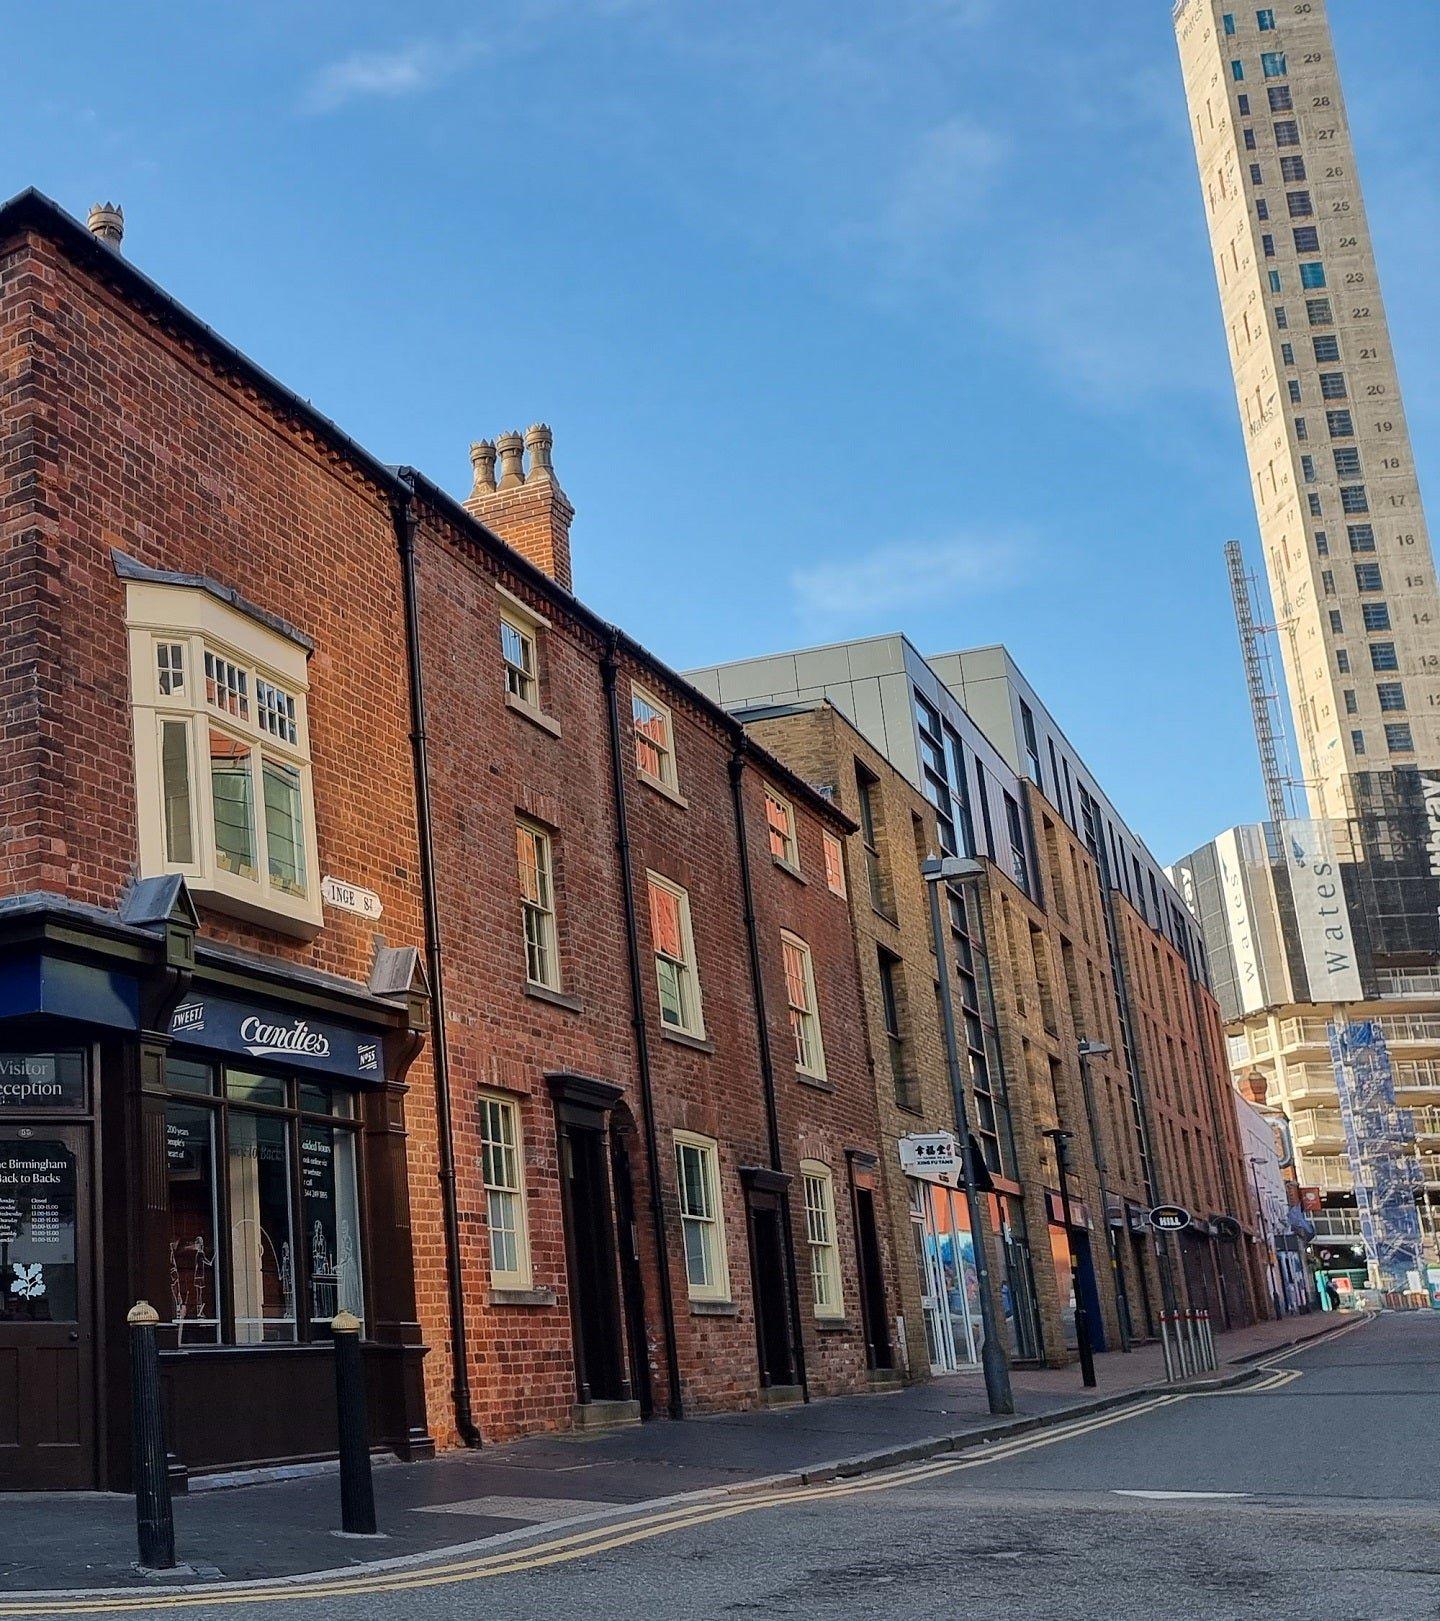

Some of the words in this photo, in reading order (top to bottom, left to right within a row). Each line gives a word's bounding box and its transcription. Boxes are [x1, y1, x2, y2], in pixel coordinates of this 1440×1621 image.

[1294, 3, 1312, 15] 30
[1304, 53, 1322, 63] 29
[1313, 96, 1331, 107] 28
[1319, 130, 1335, 140] 27
[1325, 167, 1344, 178] 26
[1332, 202, 1350, 212] 25
[1339, 237, 1358, 248] 24
[1346, 273, 1365, 283] 23
[1352, 308, 1372, 319] 22
[1360, 348, 1377, 359] 21
[1367, 385, 1386, 396] 20
[1374, 421, 1393, 433] 19
[1381, 458, 1400, 469] 18
[1389, 495, 1406, 507] 17
[1396, 534, 1415, 546] 16
[1405, 576, 1424, 588] 15
[1412, 612, 1431, 624] 14
[1419, 655, 1439, 667] 13
[331, 885, 355, 906] INGE
[1314, 862, 1351, 975] Wates
[172, 1006, 204, 1029] SWEETS
[240, 1016, 330, 1055] Candies
[302, 1139, 317, 1151] uided
[9, 1159, 67, 1171] Birmingham
[21, 1174, 31, 1183] to
[32, 1173, 61, 1184] Backs
